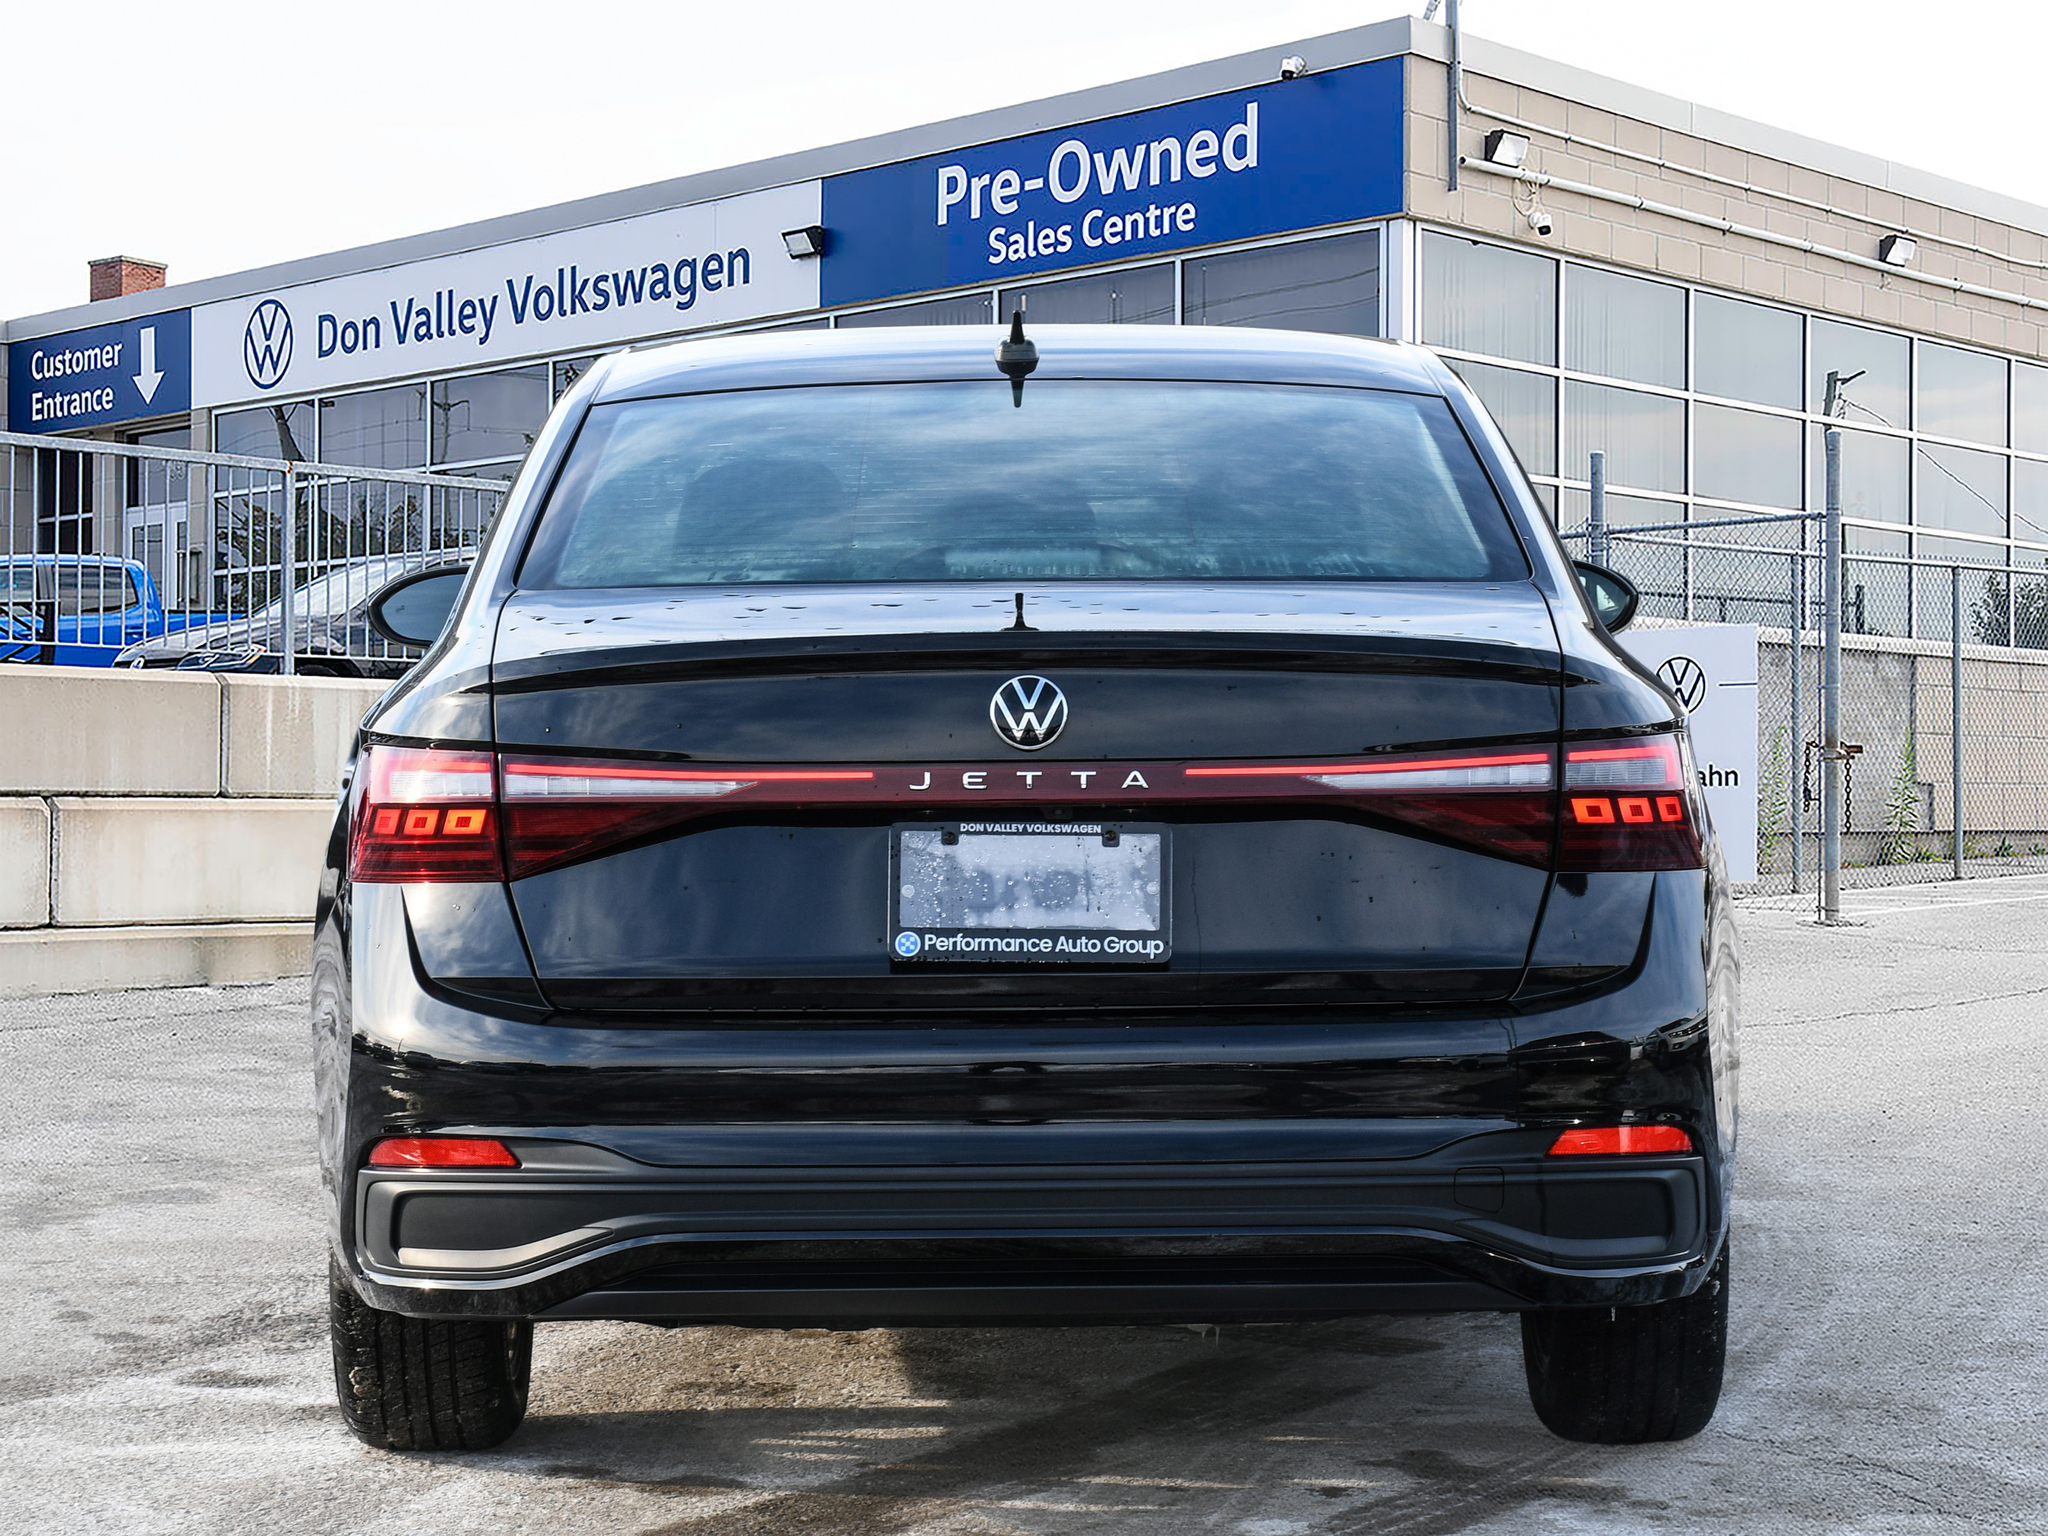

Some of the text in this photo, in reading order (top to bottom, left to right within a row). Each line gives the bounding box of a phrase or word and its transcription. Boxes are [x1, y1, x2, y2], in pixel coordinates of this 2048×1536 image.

[937, 102, 1258, 226] Pre-Owned
[988, 201, 1196, 265] Sales Centre
[318, 246, 750, 359] Don Valley Volkswagen
[31, 340, 122, 382] Customer
[31, 386, 114, 422] Entrance
[909, 770, 1149, 790] JETTA
[960, 823, 1101, 834] DON VALLEY VOLKSWAGEN
[924, 934, 1164, 960] Performance Auto Group
